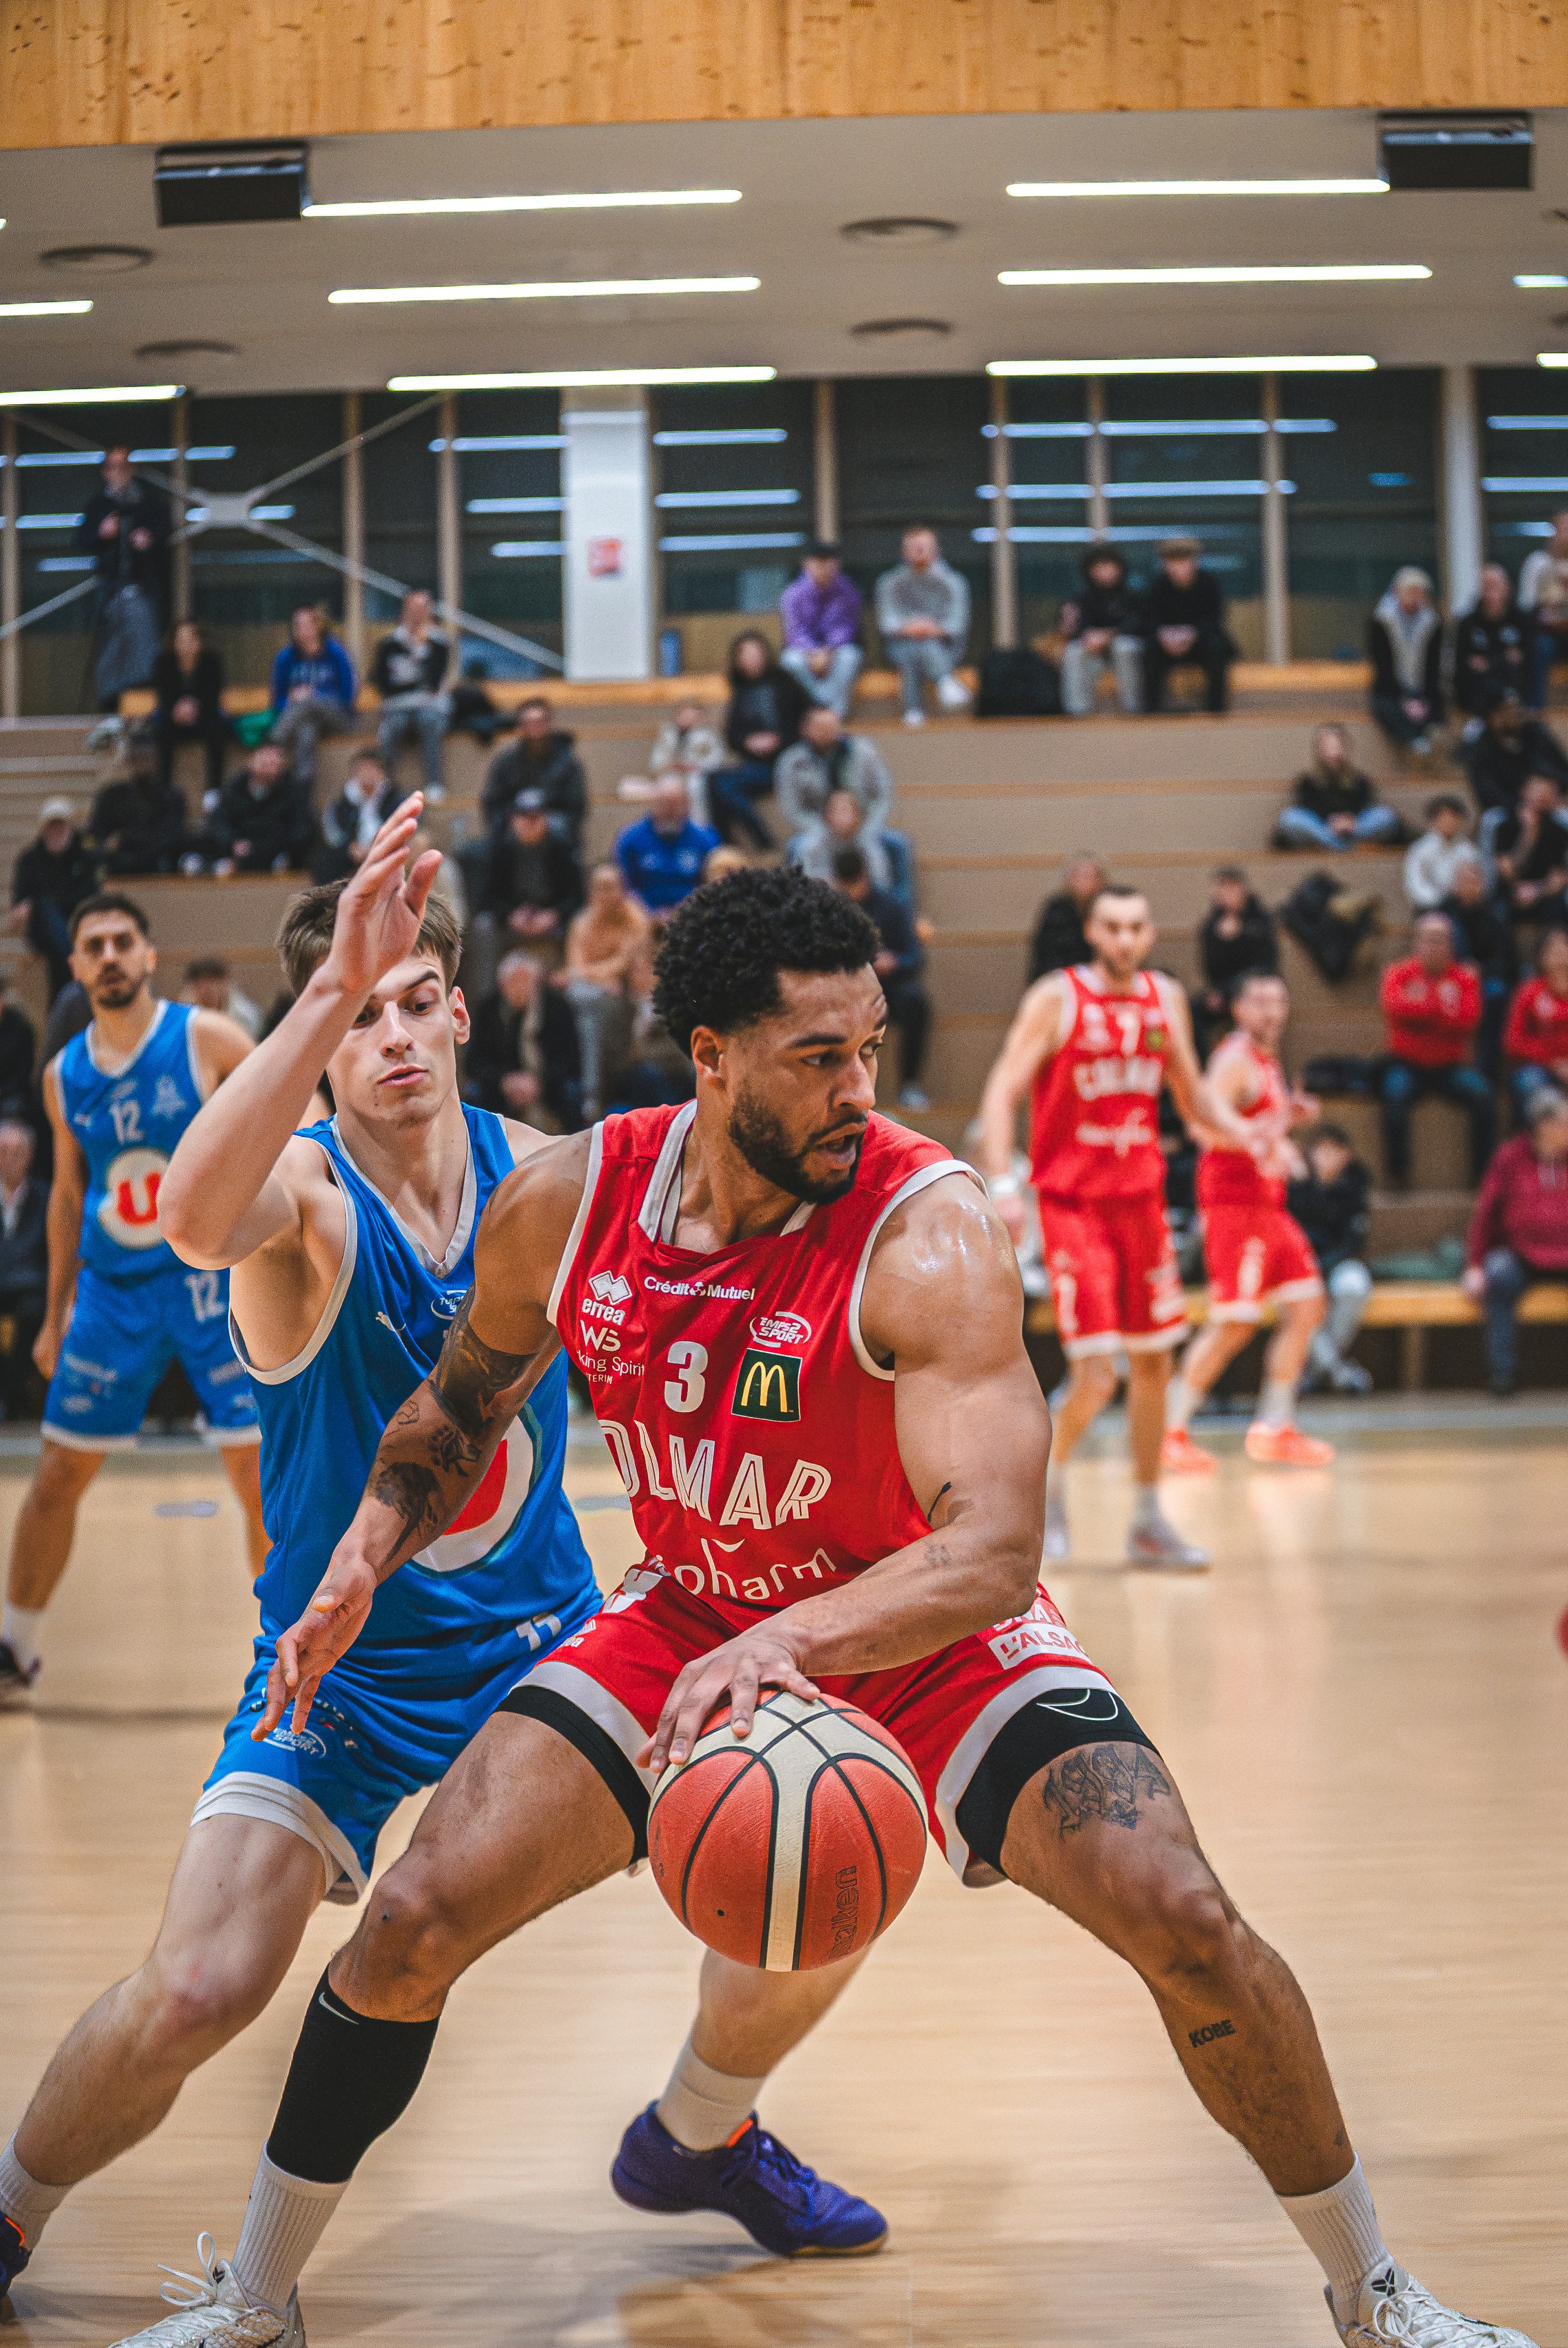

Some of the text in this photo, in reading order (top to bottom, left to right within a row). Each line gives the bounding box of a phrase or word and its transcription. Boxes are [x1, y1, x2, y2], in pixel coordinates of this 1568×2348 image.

[110, 1100, 145, 1144] 12
[184, 1271, 226, 1322] 12
[644, 1276, 755, 1300] Crédit Mutuel
[581, 1298, 626, 1326] errea
[580, 1319, 621, 1352] WS
[758, 1326, 804, 1345] SPORT
[576, 1350, 607, 1372] king
[586, 1373, 613, 1384] TERIM
[664, 1341, 708, 1413] 3
[598, 1419, 832, 1530] OLMAR
[1188, 2019, 1237, 2048] KOBE
